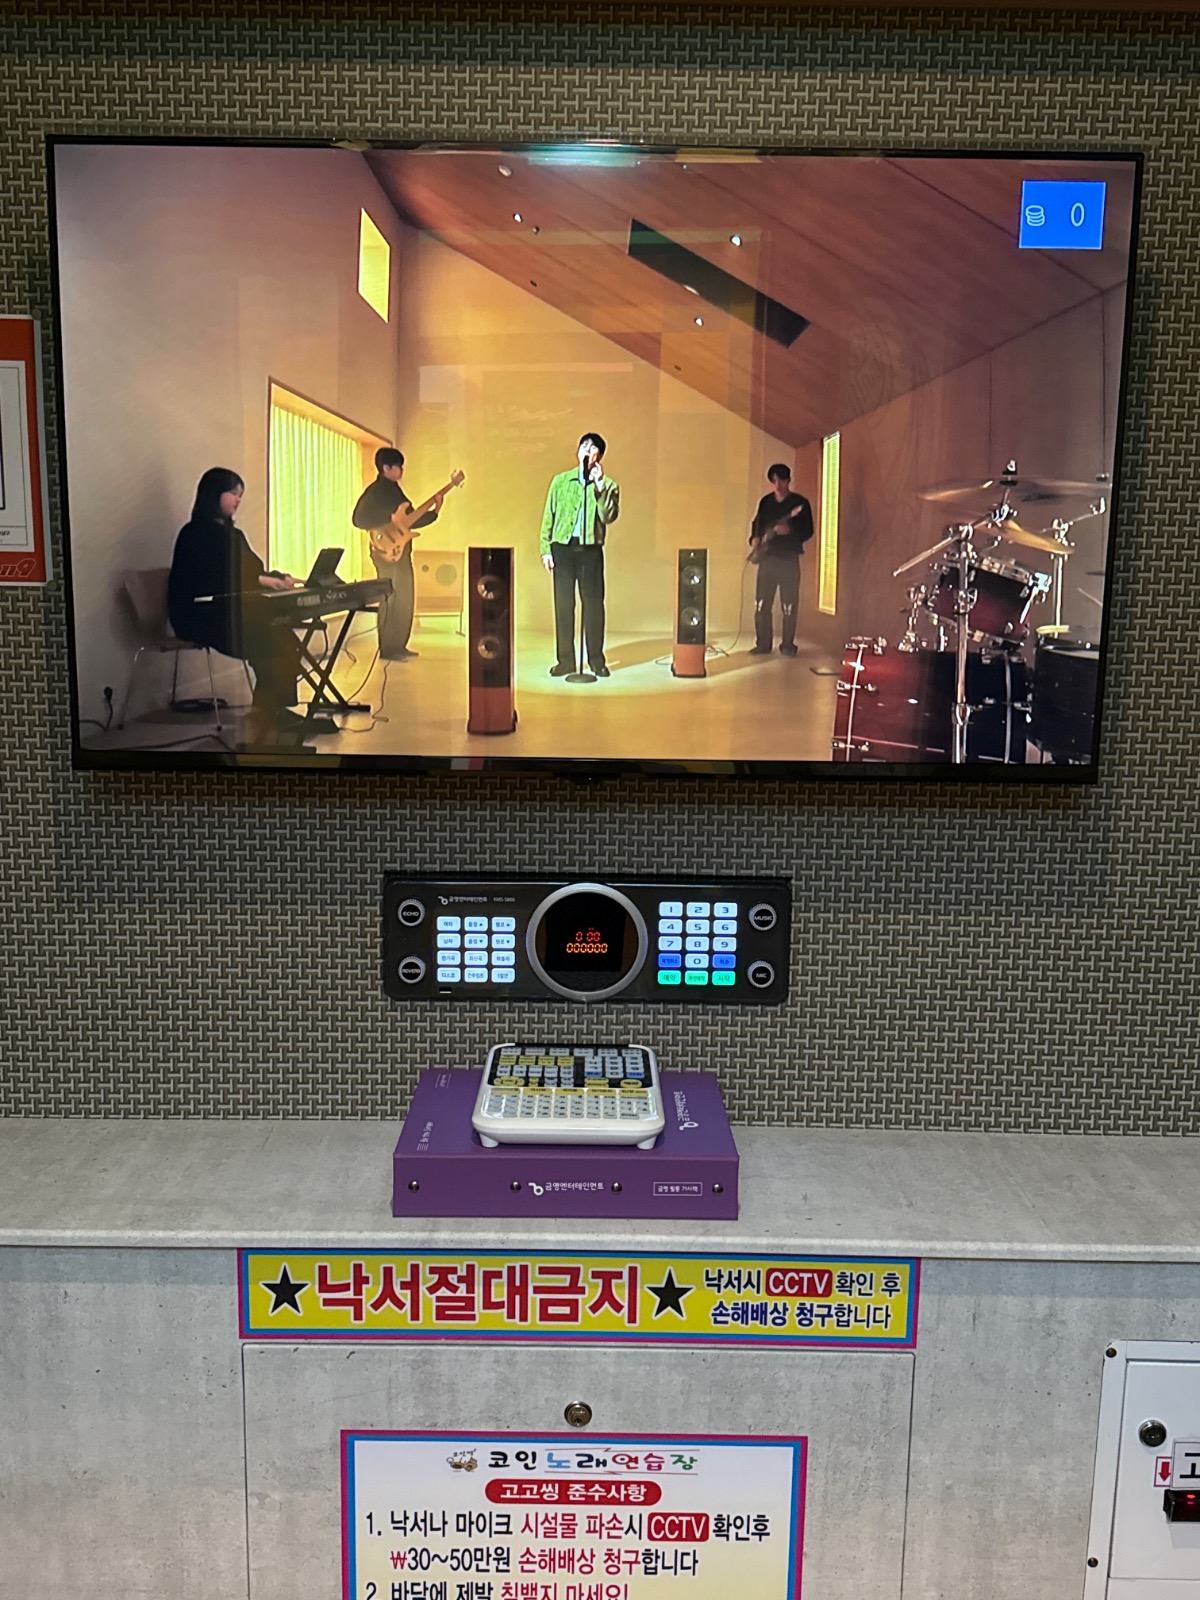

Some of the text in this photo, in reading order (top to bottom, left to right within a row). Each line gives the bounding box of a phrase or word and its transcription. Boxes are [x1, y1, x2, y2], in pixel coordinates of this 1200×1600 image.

[1071, 202, 1085, 227] 0
[575, 931, 601, 942] 0 00
[566, 943, 609, 954] 000000
[662, 974, 677, 982] 예약
[717, 975, 731, 983] 시작
[545, 1182, 604, 1191] 금영엔터테인먼트
[316, 1262, 639, 1325] 낙서절대금지
[705, 1268, 901, 1298] 낙서시 CCTV 확인 후
[711, 1301, 891, 1329] 손해배상 청구합니다
[488, 1450, 698, 1471] 코인 노래연습장
[500, 1483, 647, 1502] 고고씽 준수사항
[366, 1510, 771, 1542] 1. 낙서나 마이크 시설물 파손시 CCTV 확인후
[518, 1547, 596, 1575] 손해배상
[603, 1548, 699, 1576] 청구합니다
